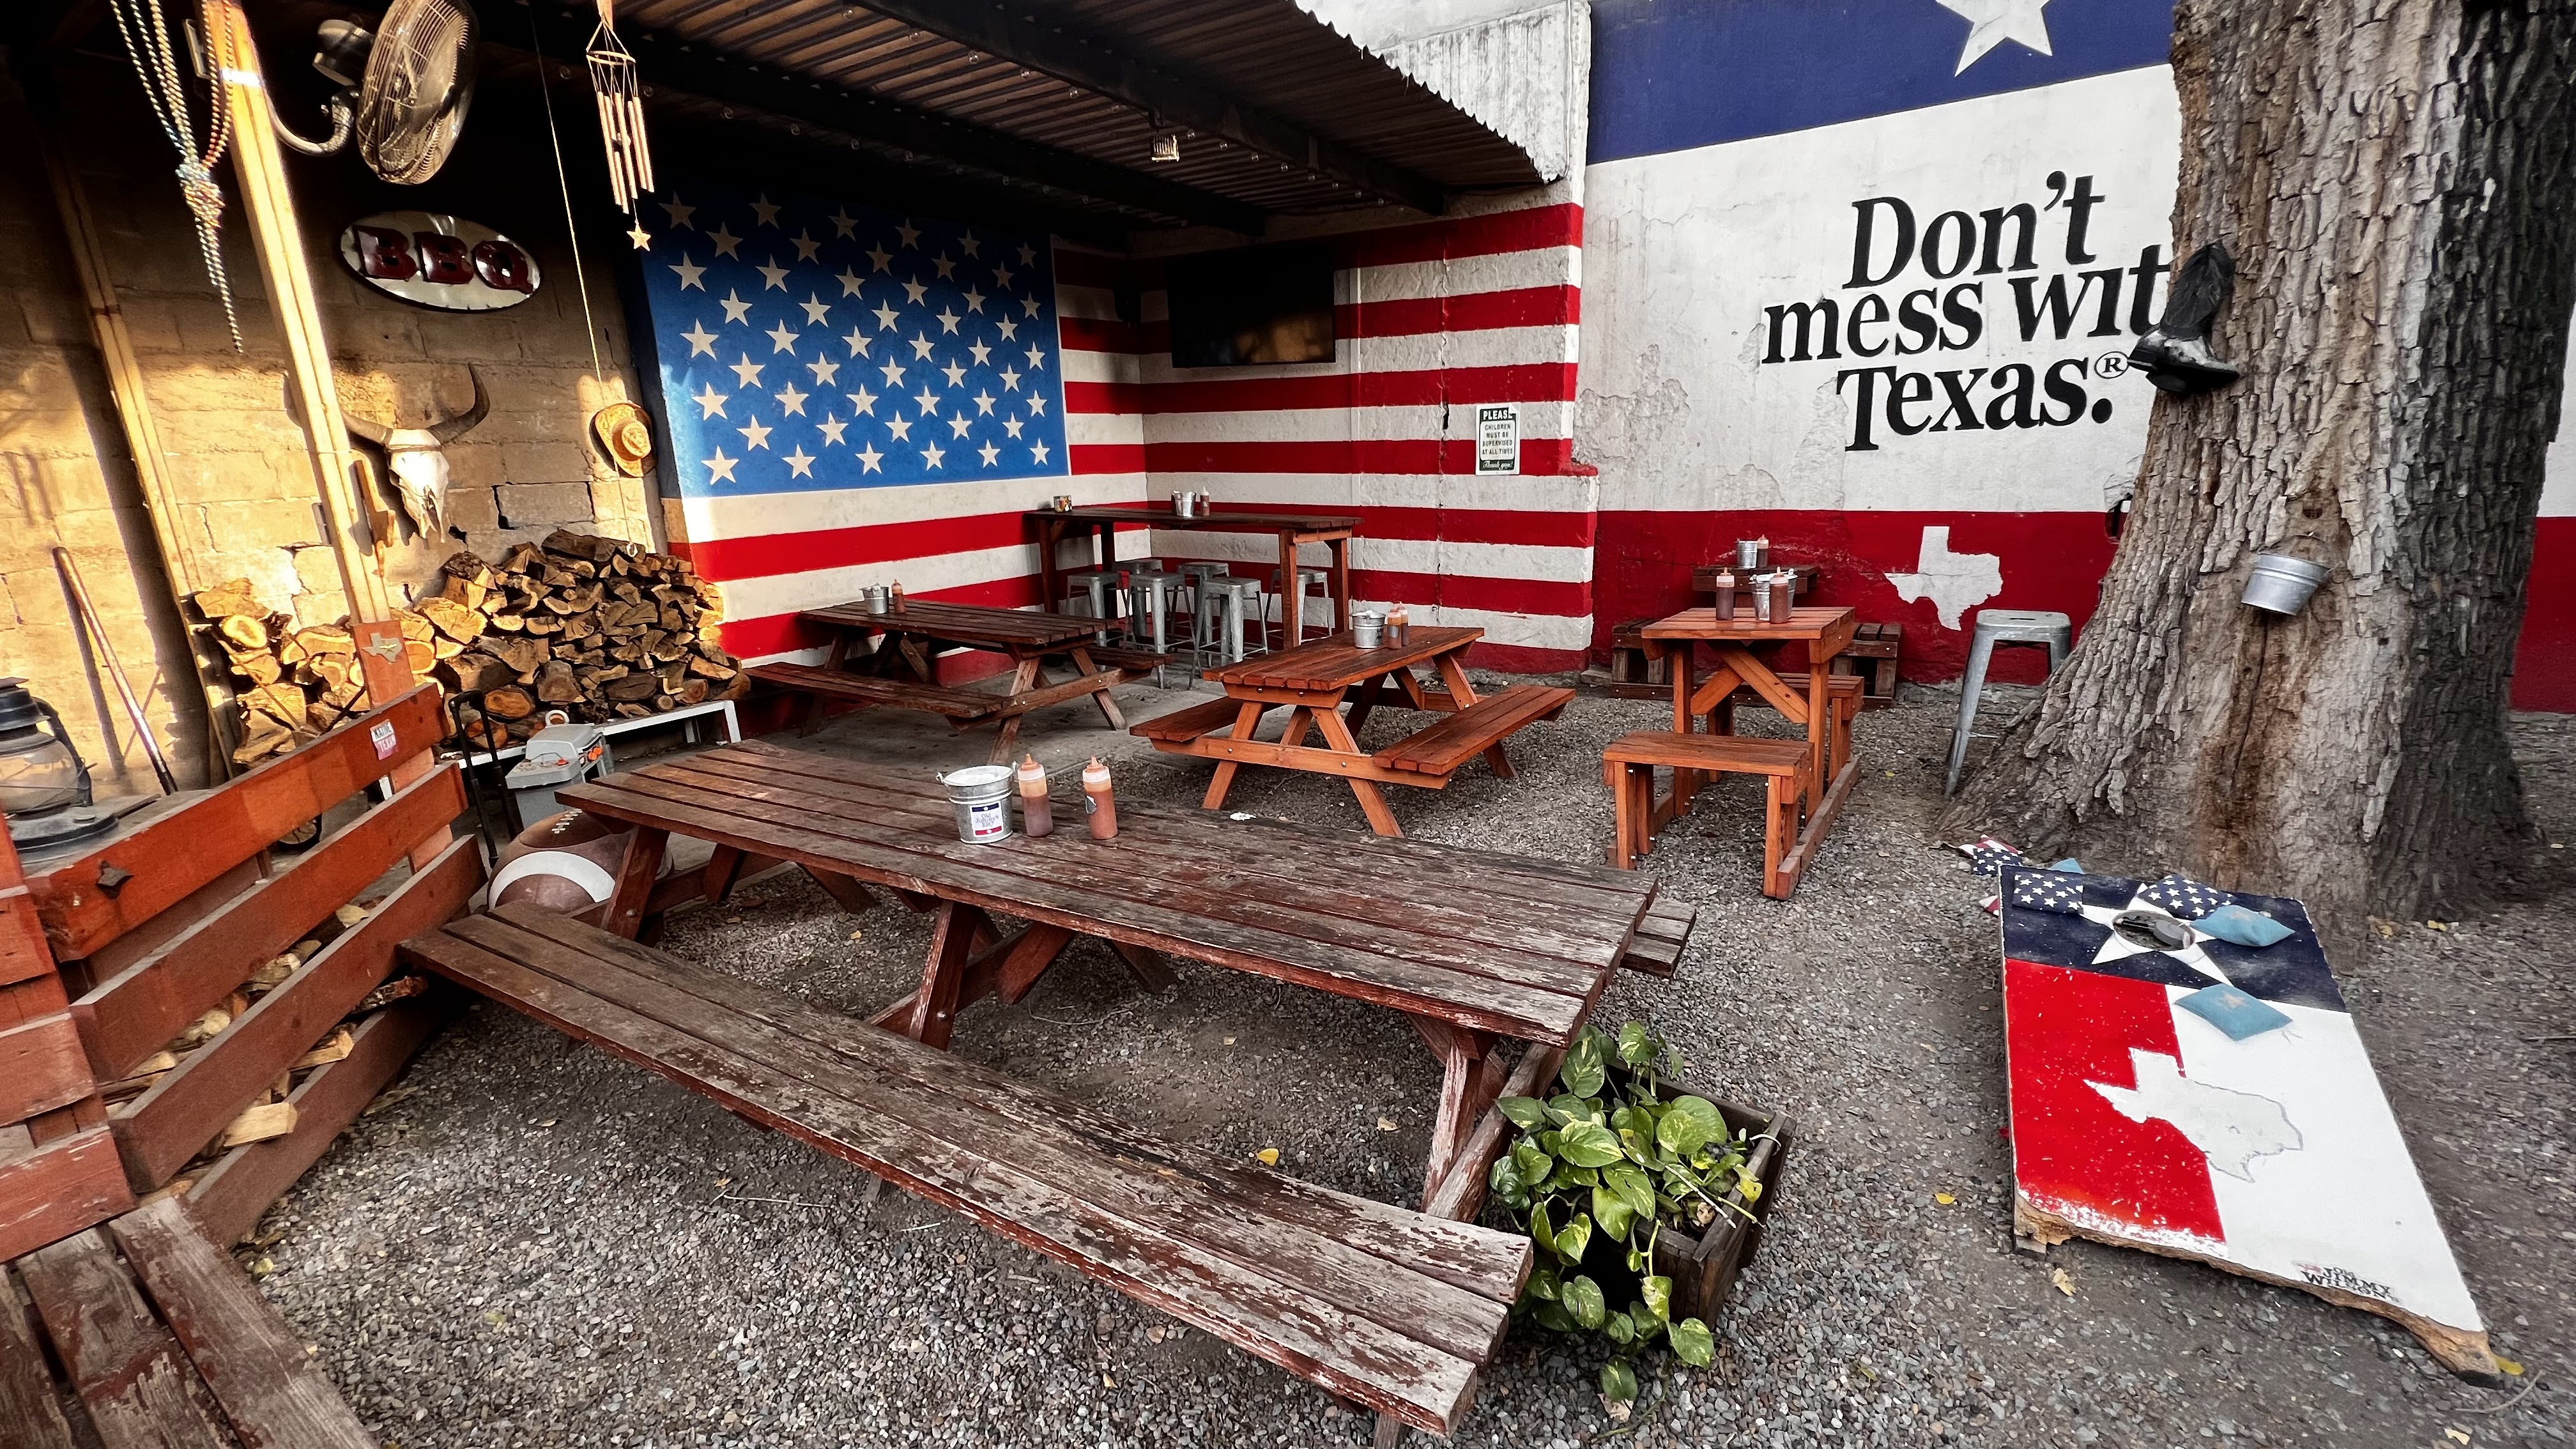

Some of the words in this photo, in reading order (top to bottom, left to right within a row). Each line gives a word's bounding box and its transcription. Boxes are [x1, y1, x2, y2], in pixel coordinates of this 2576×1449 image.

[353, 225, 533, 295] BBQ
[1843, 170, 2106, 289] Don't
[1761, 280, 1985, 364] mess
[2007, 244, 2172, 342] wit
[2323, 1267, 2391, 1294] JIMMY
